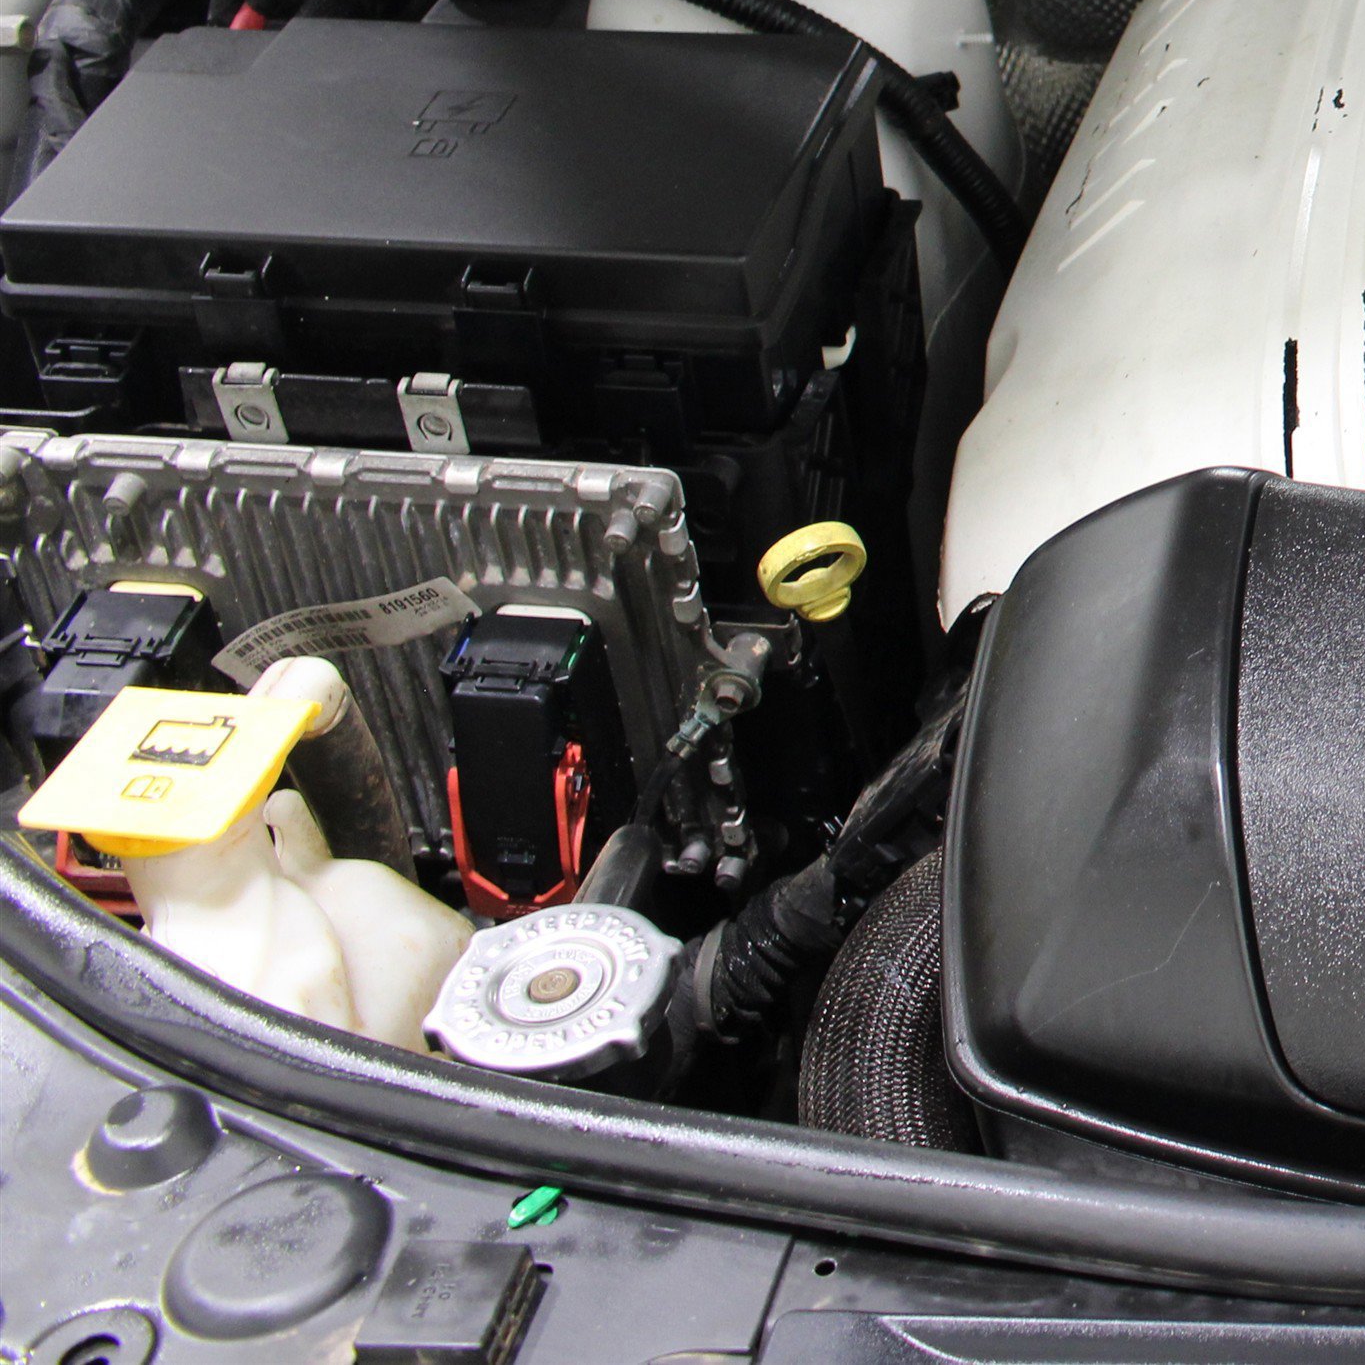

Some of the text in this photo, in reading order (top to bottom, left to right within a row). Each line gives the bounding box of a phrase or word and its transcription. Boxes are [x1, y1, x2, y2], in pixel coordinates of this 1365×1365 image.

[378, 587, 439, 615] 8191560
[515, 911, 598, 940] KEEP
[454, 965, 486, 997] DO
[486, 1029, 567, 1050] OPEN
[571, 997, 625, 1037] HOT
